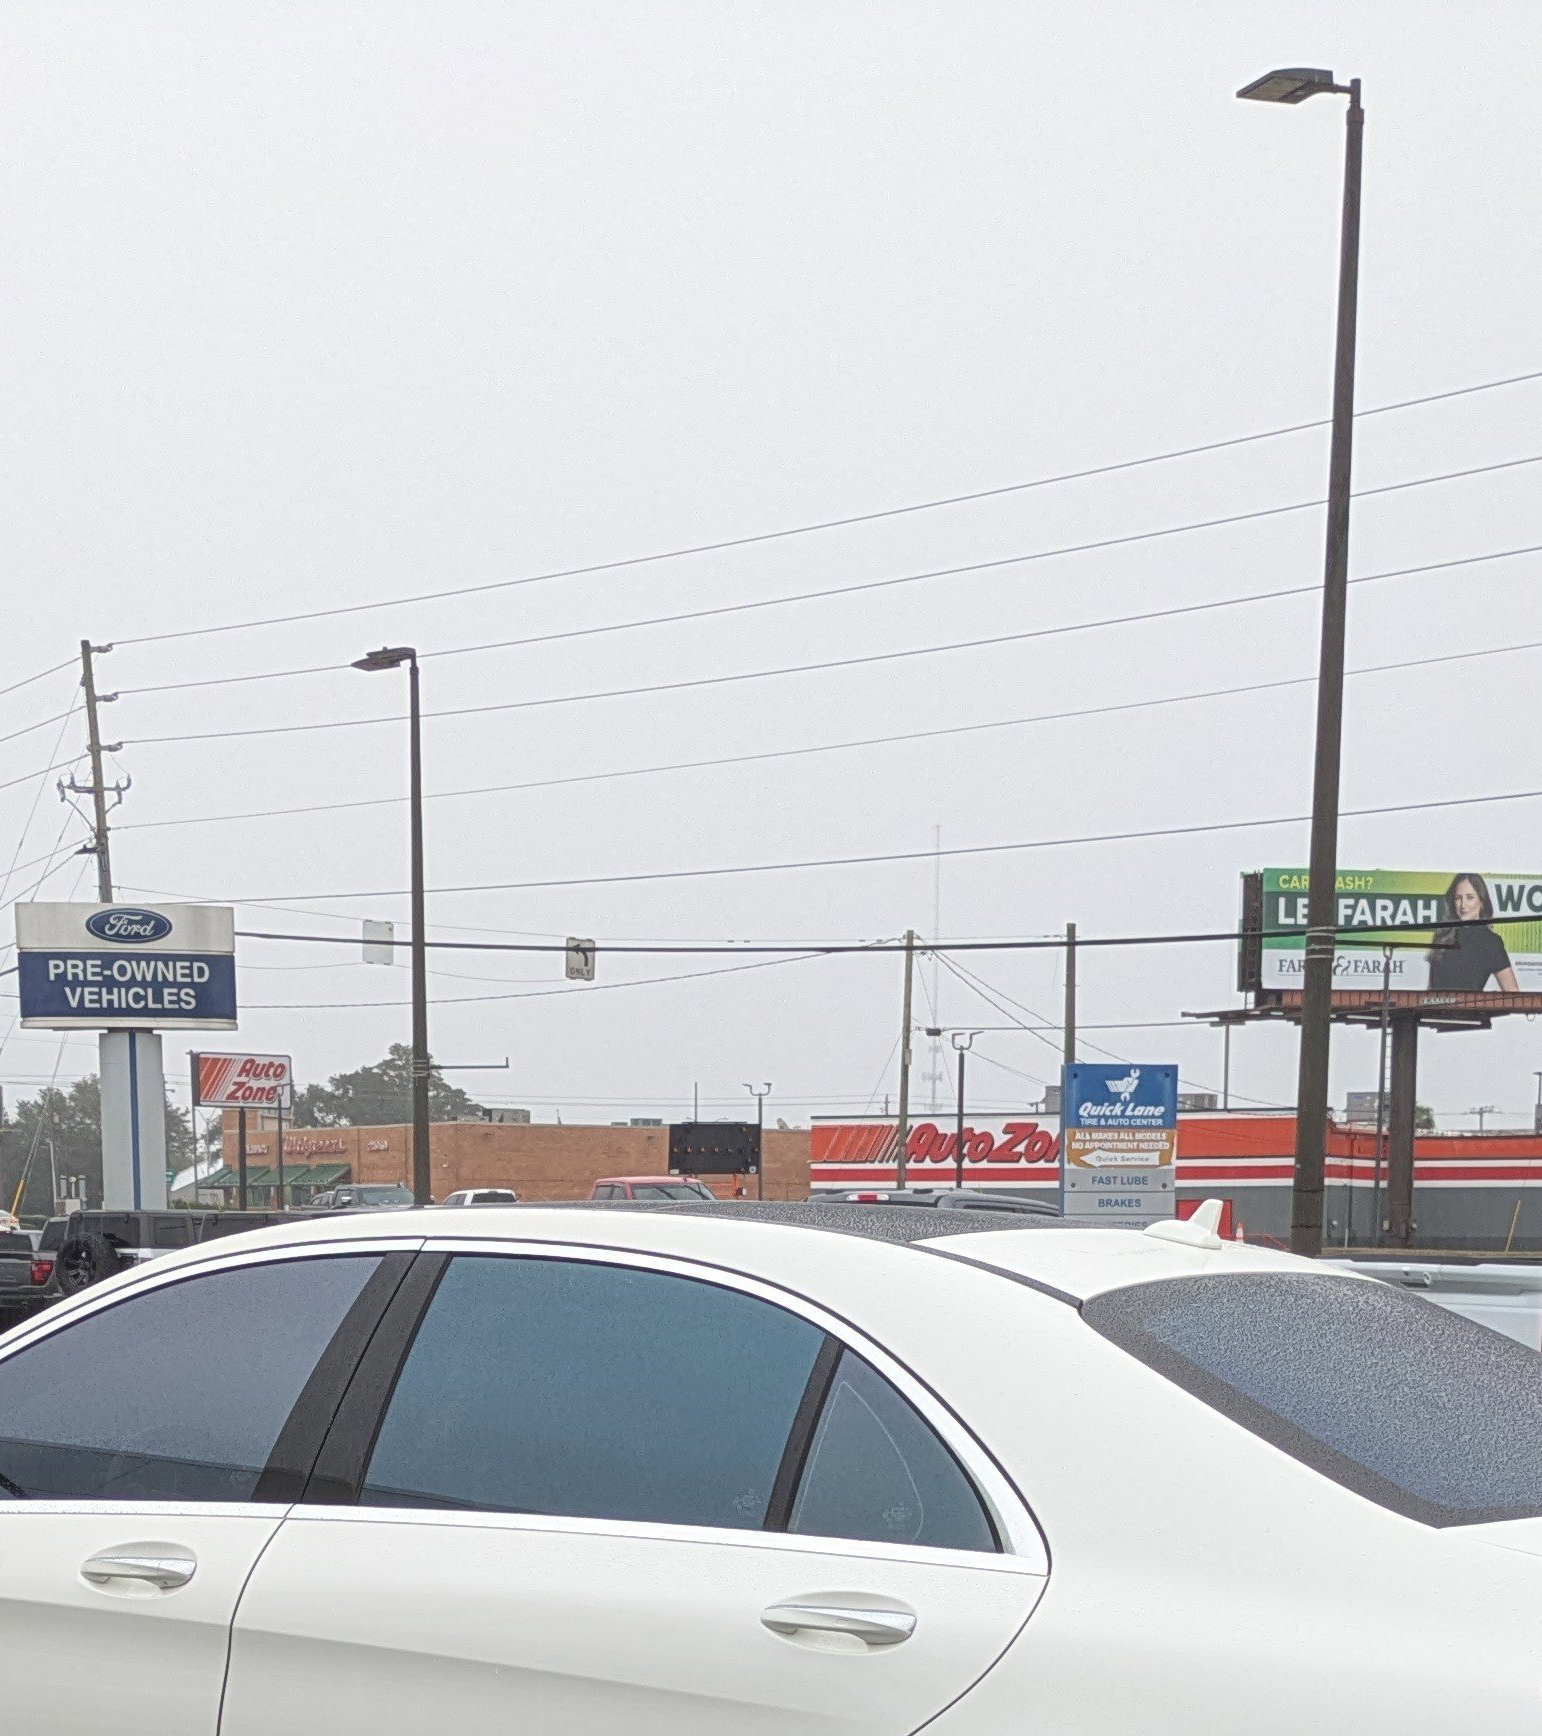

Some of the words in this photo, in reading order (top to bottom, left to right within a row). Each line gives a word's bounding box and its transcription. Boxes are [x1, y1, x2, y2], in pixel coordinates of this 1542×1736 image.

[1335, 876, 1373, 890] ASH?
[1339, 899, 1438, 925] FARAH
[104, 913, 155, 937] Ford
[48, 960, 210, 984] PRE-OWNED
[64, 987, 197, 1010] VEHICLES
[237, 1059, 287, 1079] Auto
[226, 1082, 280, 1101] Zone
[1078, 1101, 1124, 1116] Quick
[1124, 1103, 1166, 1116] Lane
[1080, 1118, 1099, 1126] TIRE
[1100, 1118, 1107, 1126] &
[1107, 1118, 1130, 1126] AUTO
[1131, 1118, 1164, 1126] CENTER
[908, 1122, 1060, 1163] AutoZo
[1075, 1131, 1090, 1140] ALL
[1091, 1131, 1118, 1140] MAKES
[1119, 1132, 1134, 1140] ALL
[1135, 1132, 1167, 1140] MODELS
[1084, 1141, 1138, 1150] APPOINTMENT
[1139, 1142, 1170, 1150] NEEDED
[1091, 1176, 1119, 1185] FAST
[1120, 1176, 1149, 1185] LUBE
[1097, 1199, 1142, 1208] BRAKES
